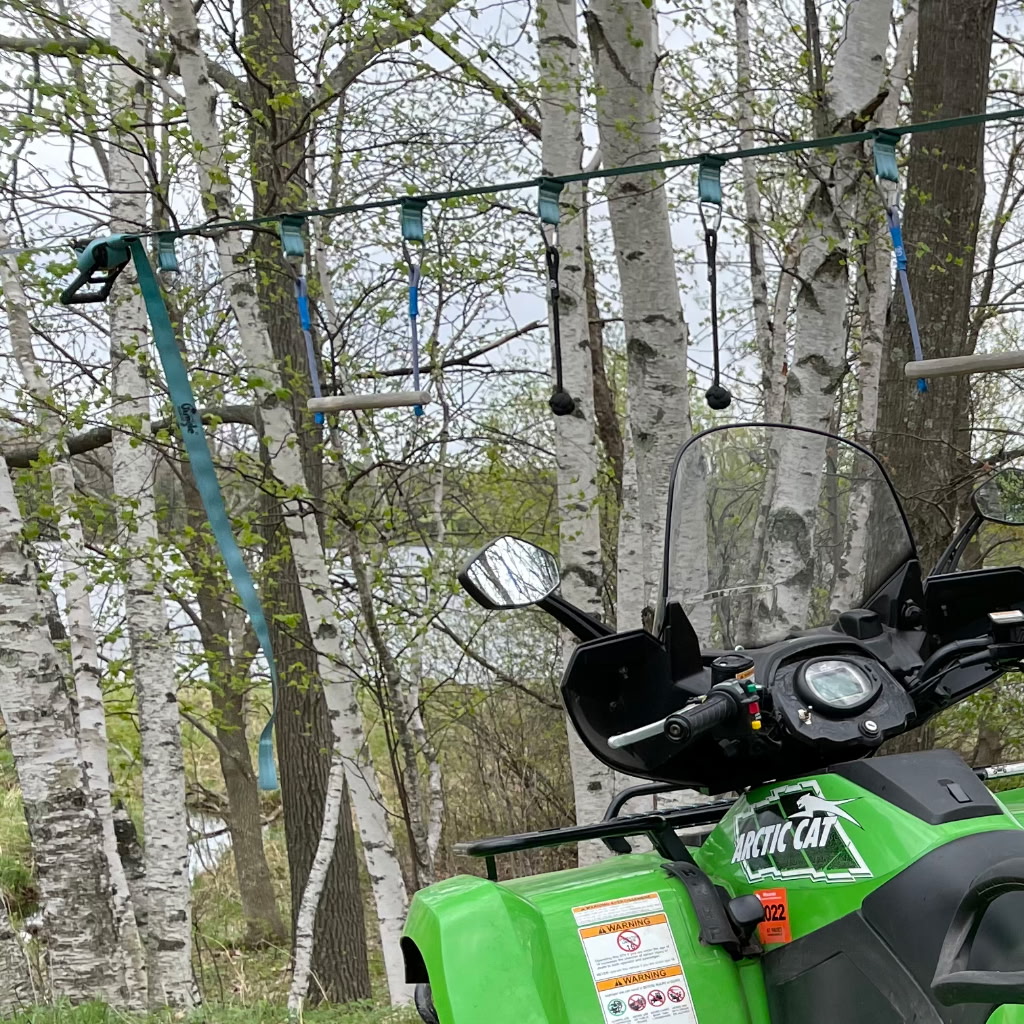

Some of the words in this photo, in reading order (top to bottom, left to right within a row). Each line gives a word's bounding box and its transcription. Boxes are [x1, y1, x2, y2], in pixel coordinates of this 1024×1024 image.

[731, 821, 792, 864] ARCTIC
[793, 816, 838, 850] CAT
[762, 904, 786, 922] 022
[607, 917, 651, 932] WARNING
[623, 970, 667, 985] WARNING
